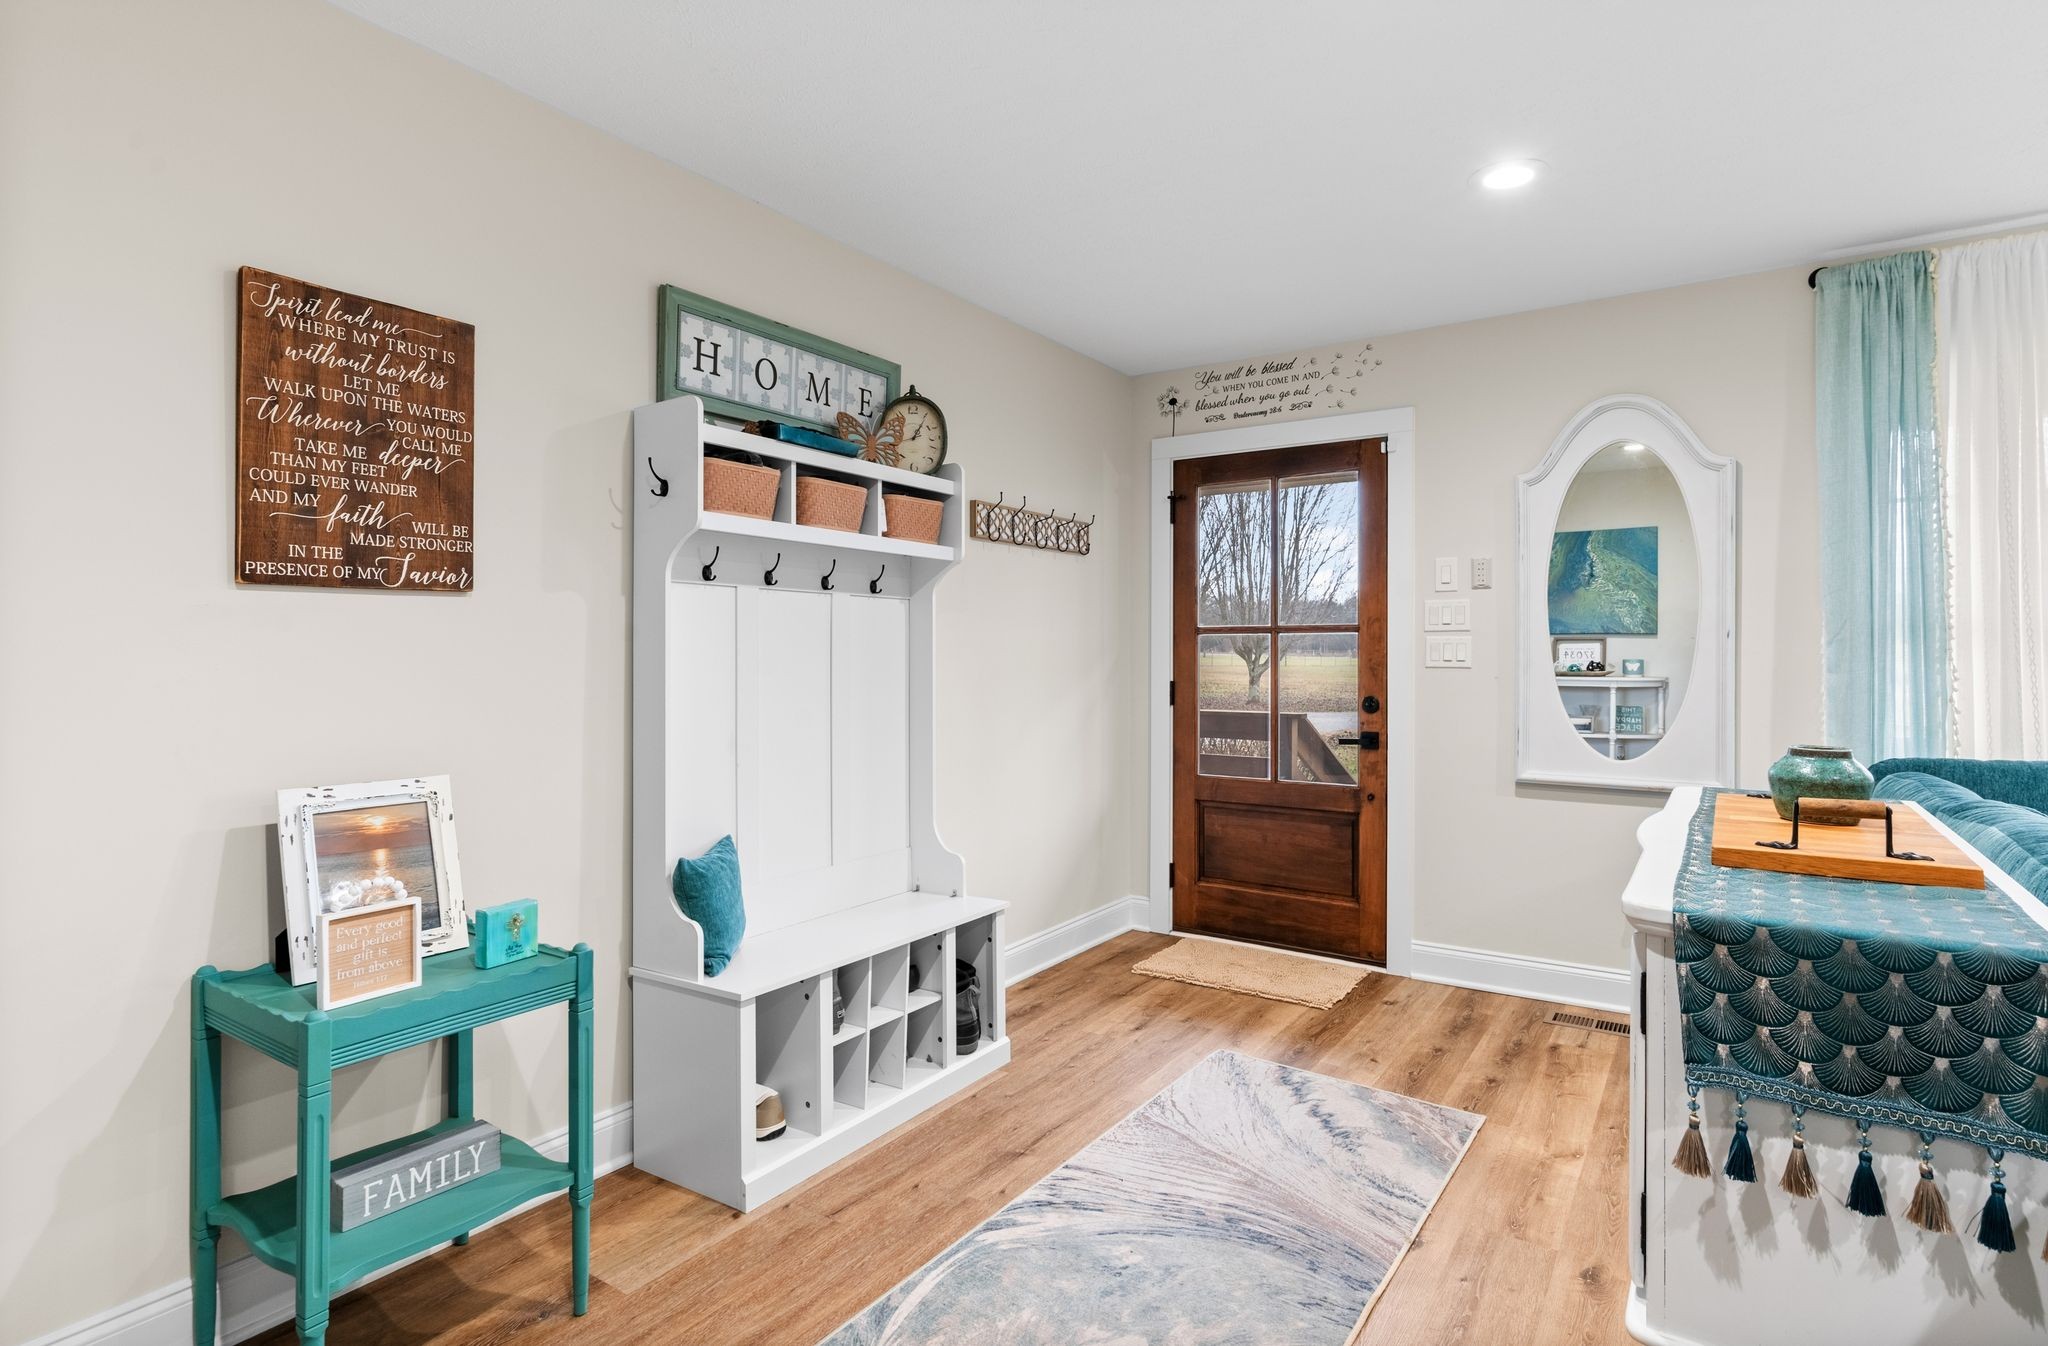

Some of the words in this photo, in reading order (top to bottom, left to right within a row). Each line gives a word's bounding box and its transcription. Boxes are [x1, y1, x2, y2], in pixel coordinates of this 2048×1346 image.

[248, 282, 323, 317] Spirit
[325, 297, 373, 327] lead
[277, 312, 347, 341] WHERE
[352, 330, 380, 348] MY
[385, 337, 437, 359] TRUST
[442, 350, 456, 364] IS
[285, 341, 375, 374] without
[376, 353, 449, 390] borders
[692, 336, 873, 419] HOME
[1195, 372, 1222, 390] You
[1224, 366, 1243, 380] will
[1246, 364, 1257, 376] be
[1261, 357, 1297, 374] blessed
[343, 374, 373, 391] LET
[377, 381, 400, 397] ME
[1222, 383, 1246, 393] WHEN
[1247, 380, 1264, 389] YOU
[1266, 376, 1289, 387] COME
[1291, 374, 1299, 382] IN
[1302, 371, 1320, 381] AND
[263, 376, 317, 398] WALK
[321, 386, 367, 407] UPON
[372, 396, 402, 413] THE
[407, 403, 466, 424] WATERS
[1195, 395, 1229, 412] blessed
[1229, 391, 1255, 406] when
[1259, 391, 1275, 405] you
[1279, 390, 1291, 402] go
[1293, 385, 1311, 396] out
[246, 395, 386, 437] Wherever
[386, 418, 417, 435] YOU
[421, 425, 473, 443] WOULD
[293, 437, 338, 456] TAKE
[342, 444, 367, 460] ME
[378, 440, 466, 480] deeper
[402, 436, 438, 453] CALL
[441, 442, 462, 457] ME
[270, 451, 317, 469] THAN
[321, 459, 347, 473] MY
[351, 462, 388, 478] FEET
[249, 467, 306, 485] COULD
[311, 474, 350, 490] EVER
[354, 479, 418, 498] WANDER
[249, 488, 288, 504] AND
[293, 491, 322, 507] MY
[411, 521, 448, 537] WILL
[452, 525, 469, 538] BE
[288, 544, 306, 558] IN
[311, 545, 343, 560] THE
[350, 532, 395, 547] MADE
[399, 535, 473, 553] STRONGER
[244, 561, 328, 577] PRESENCE
[332, 566, 352, 578] OF
[357, 567, 382, 580] MY
[375, 552, 473, 589] Savior
[336, 925, 370, 939] Every
[375, 916, 403, 934] good
[336, 938, 358, 953] and
[362, 930, 402, 951] perfect
[336, 967, 364, 980] from
[368, 958, 403, 973] above
[352, 948, 374, 965] gift
[378, 947, 388, 957] is
[362, 1141, 486, 1218] FAMILY
